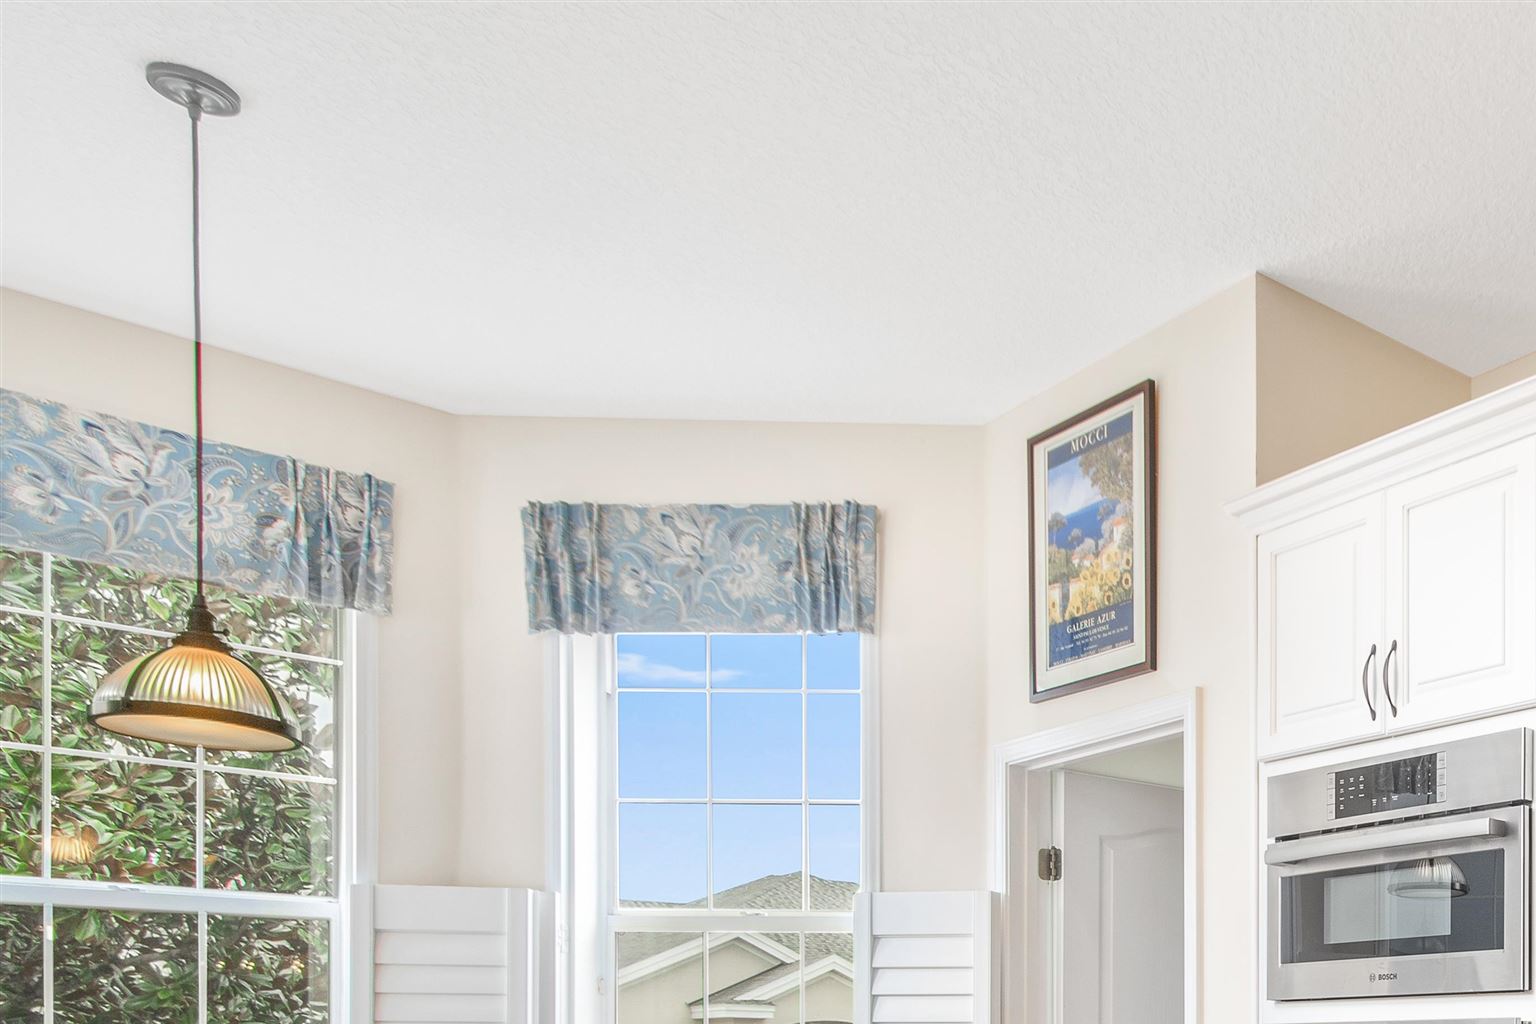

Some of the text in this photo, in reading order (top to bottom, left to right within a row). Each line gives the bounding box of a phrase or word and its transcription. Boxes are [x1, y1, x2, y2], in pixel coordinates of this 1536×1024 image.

[1071, 424, 1108, 453] MOCCI
[1066, 617, 1095, 634] GALERIE
[1096, 610, 1116, 625] AZUR
[1378, 973, 1397, 981] BOSCH
